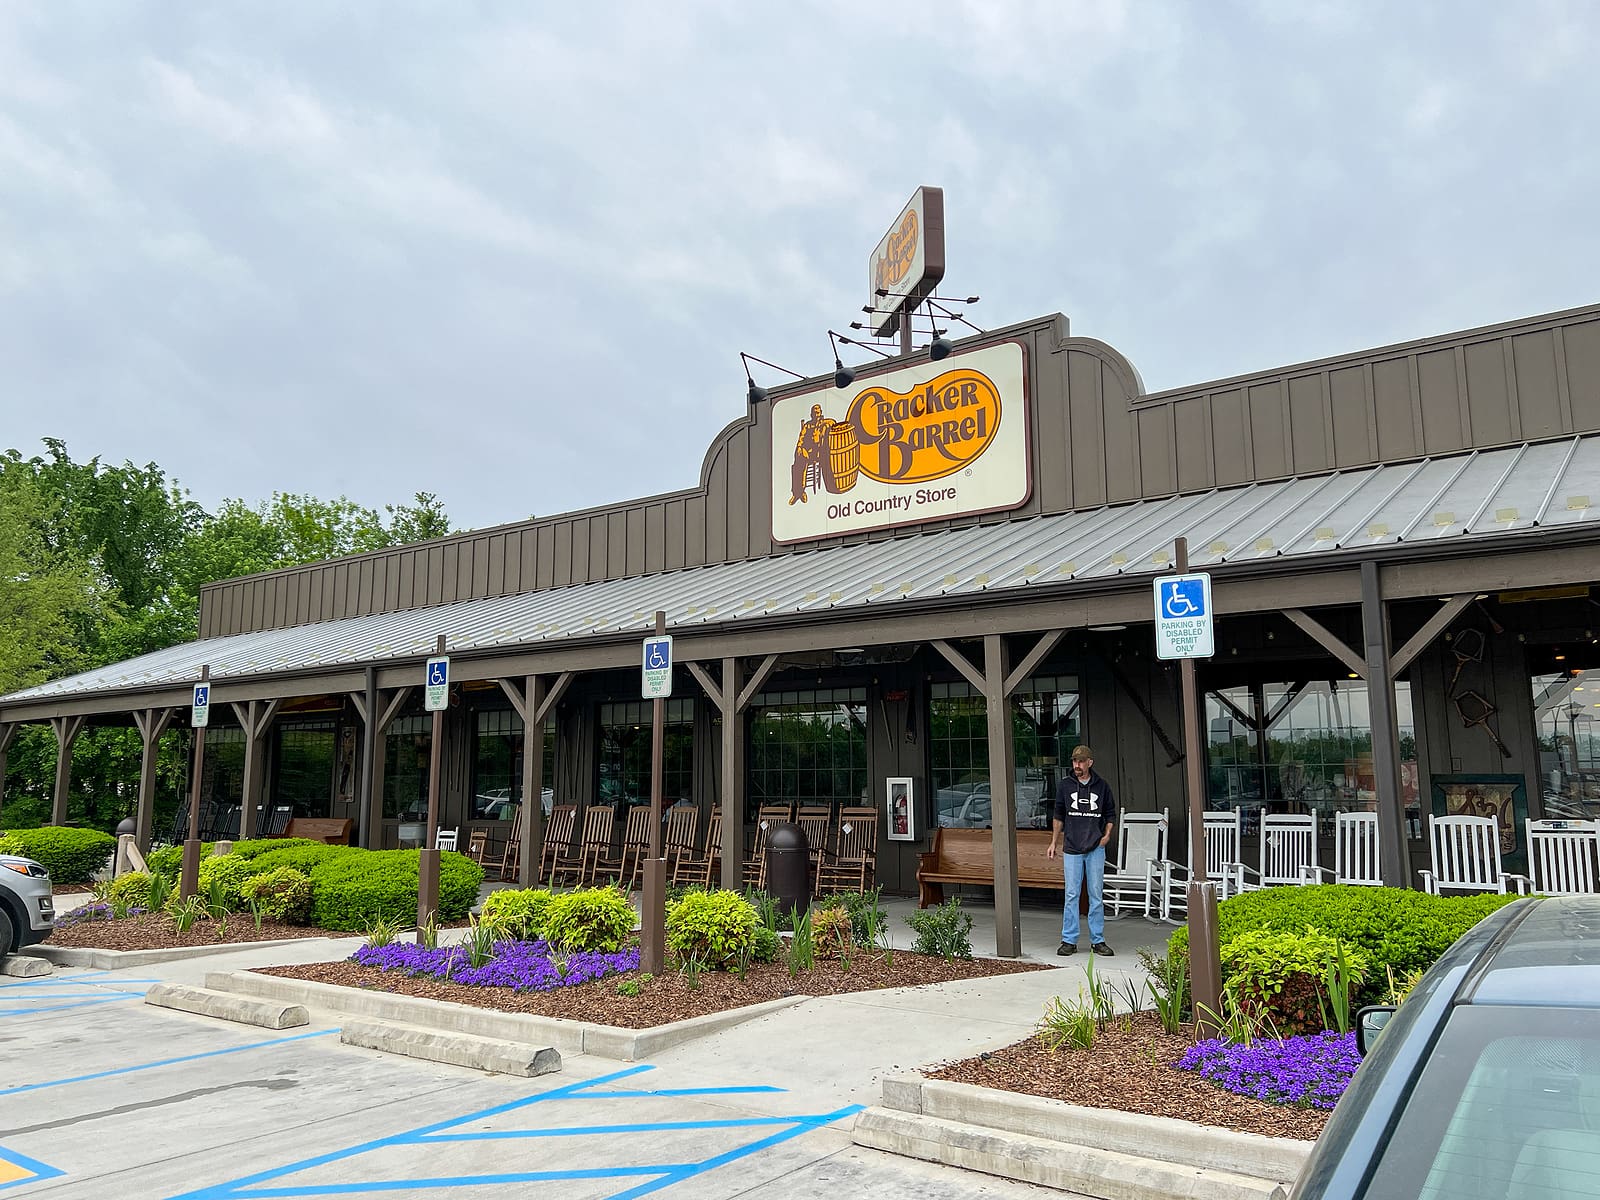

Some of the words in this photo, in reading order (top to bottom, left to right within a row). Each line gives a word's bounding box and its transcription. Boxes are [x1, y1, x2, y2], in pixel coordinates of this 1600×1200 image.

[849, 382, 980, 446] Cracker
[878, 407, 987, 479] Barrel
[827, 502, 851, 520] Old
[854, 494, 912, 516] Country
[915, 487, 957, 505] Store
[1161, 621, 1194, 630] PARKING
[1166, 628, 1203, 638] DISABLED
[1171, 637, 1198, 645] PERMIT
[1175, 645, 1195, 653] ONLY
